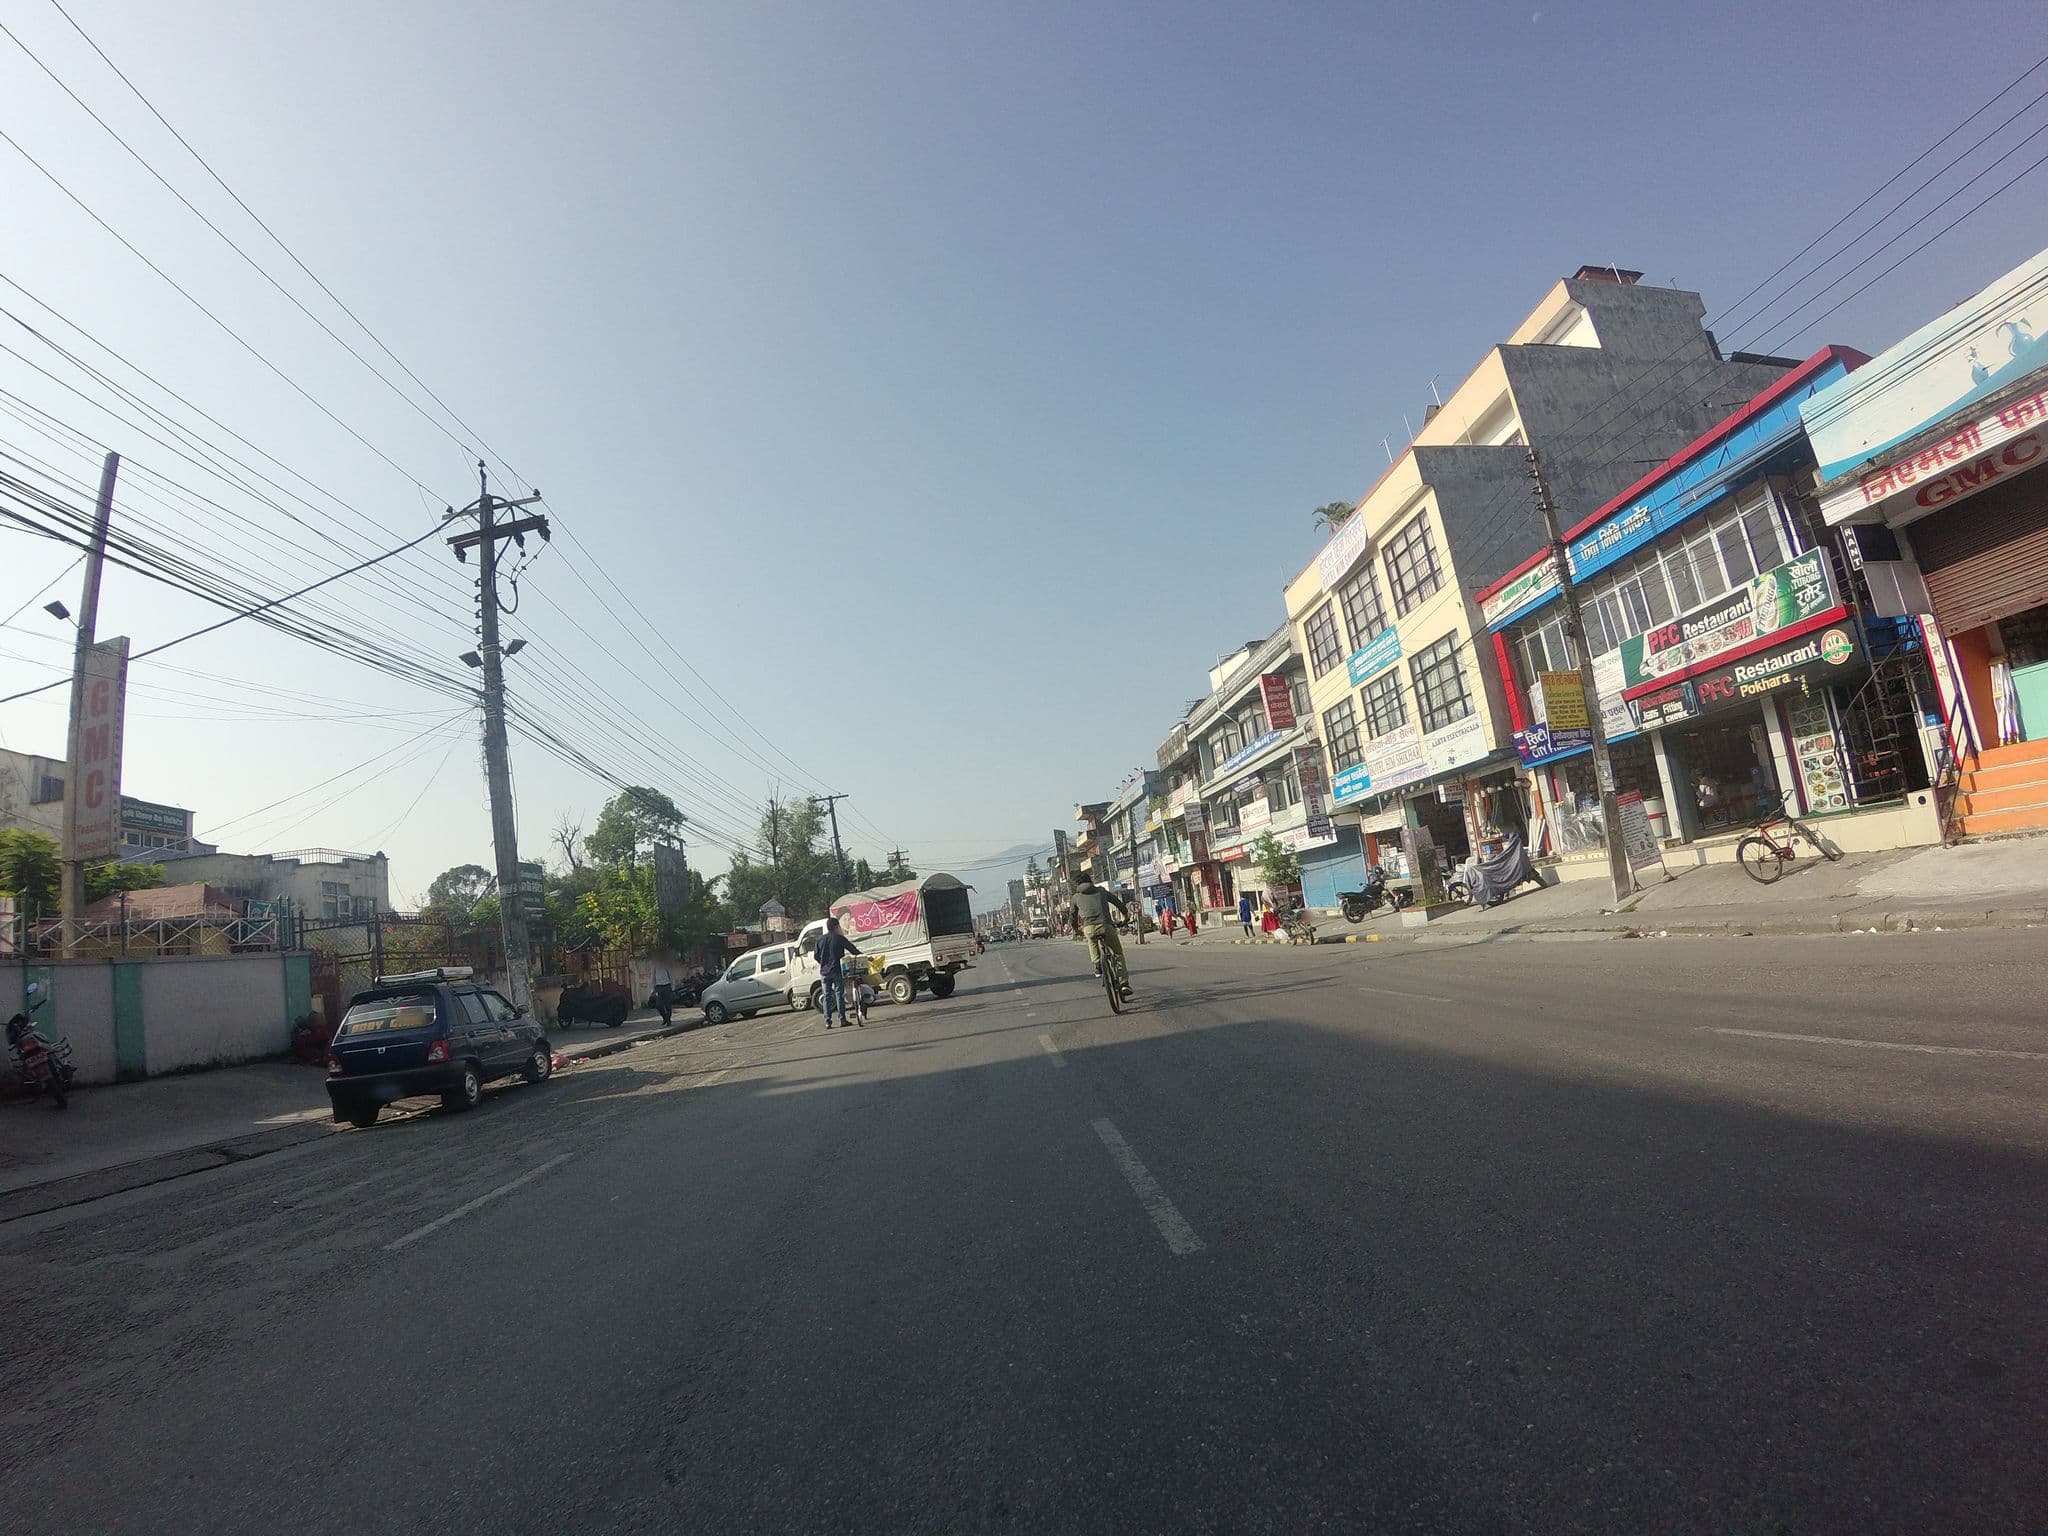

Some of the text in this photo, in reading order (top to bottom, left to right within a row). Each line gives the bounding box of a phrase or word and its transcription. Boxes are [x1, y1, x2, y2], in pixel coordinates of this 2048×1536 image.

[1915, 432, 2043, 508] GMC
[1791, 571, 1821, 591] TUBORG
[1647, 597, 1751, 655] PFC Restaurant
[1735, 639, 1818, 683] Restaurant
[1699, 674, 1735, 705] PFC
[1739, 672, 1791, 698] Pokhara
[1531, 746, 1548, 759] CITY
